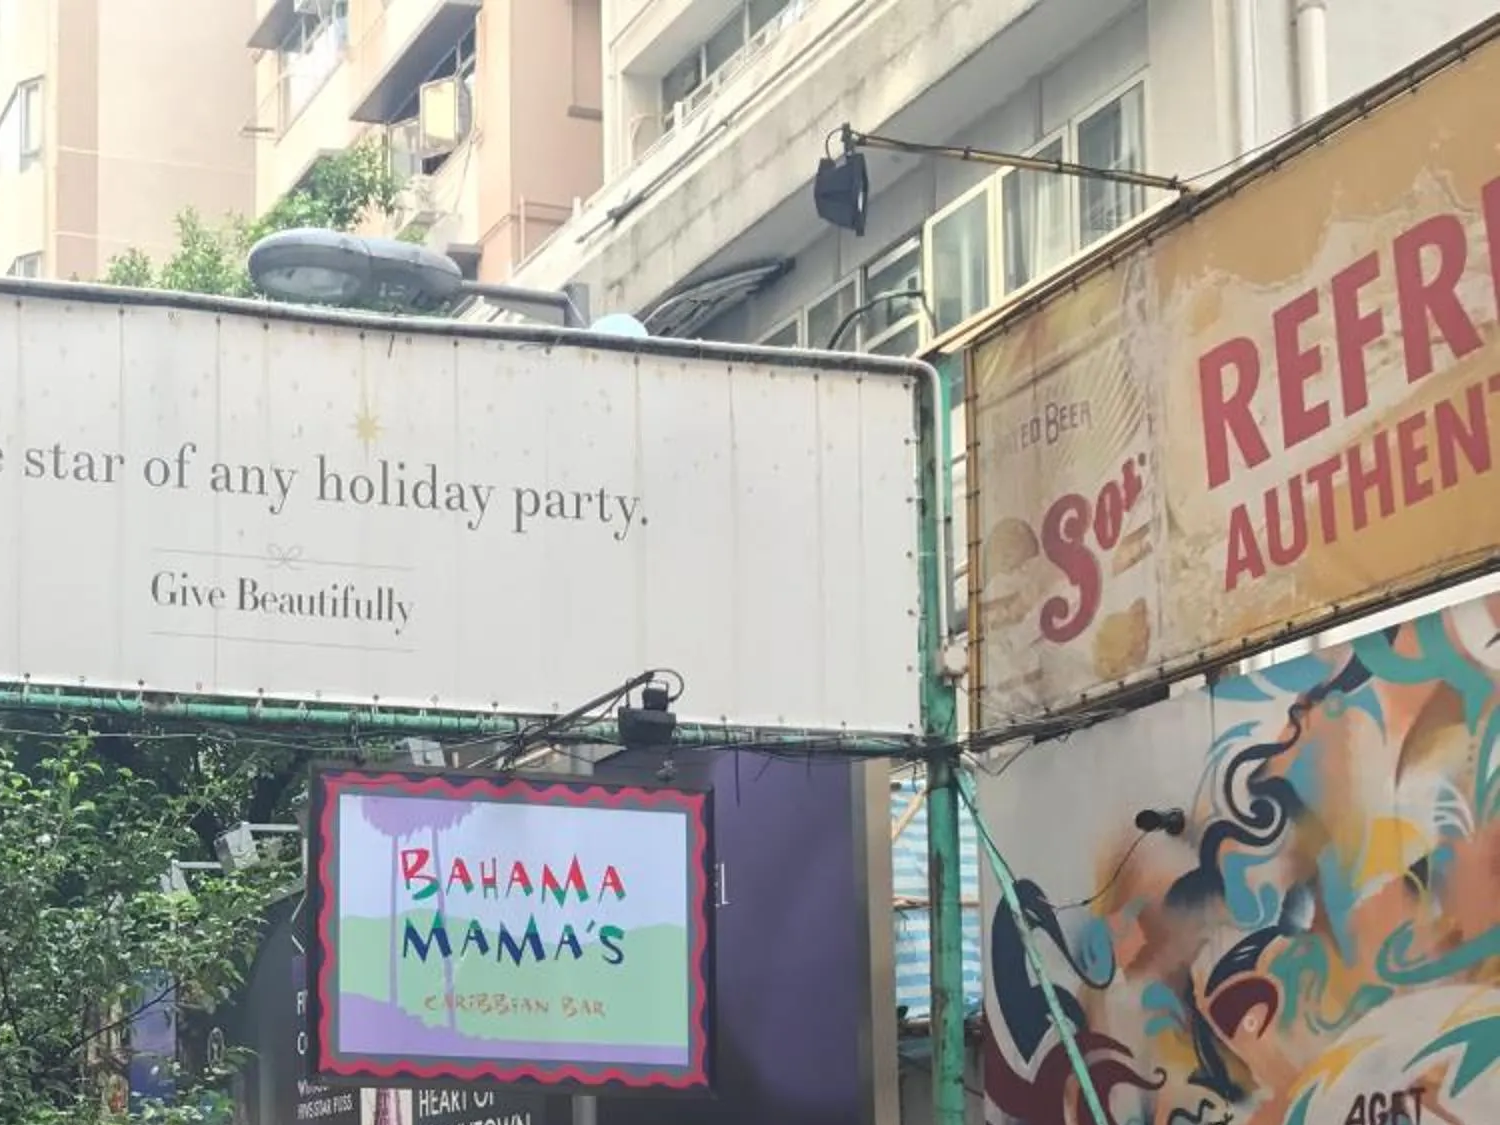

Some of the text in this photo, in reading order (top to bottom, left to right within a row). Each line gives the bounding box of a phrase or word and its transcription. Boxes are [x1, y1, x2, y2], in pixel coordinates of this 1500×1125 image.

[24, 441, 125, 483] star
[143, 442, 197, 489] of
[210, 461, 299, 515] any
[317, 454, 496, 531] holiday
[512, 486, 648, 541] party.
[151, 570, 414, 636] Give Beautifully
[401, 847, 627, 909] BAHAMA
[402, 909, 625, 968] MAMA'S
[562, 996, 606, 1018] BAR
